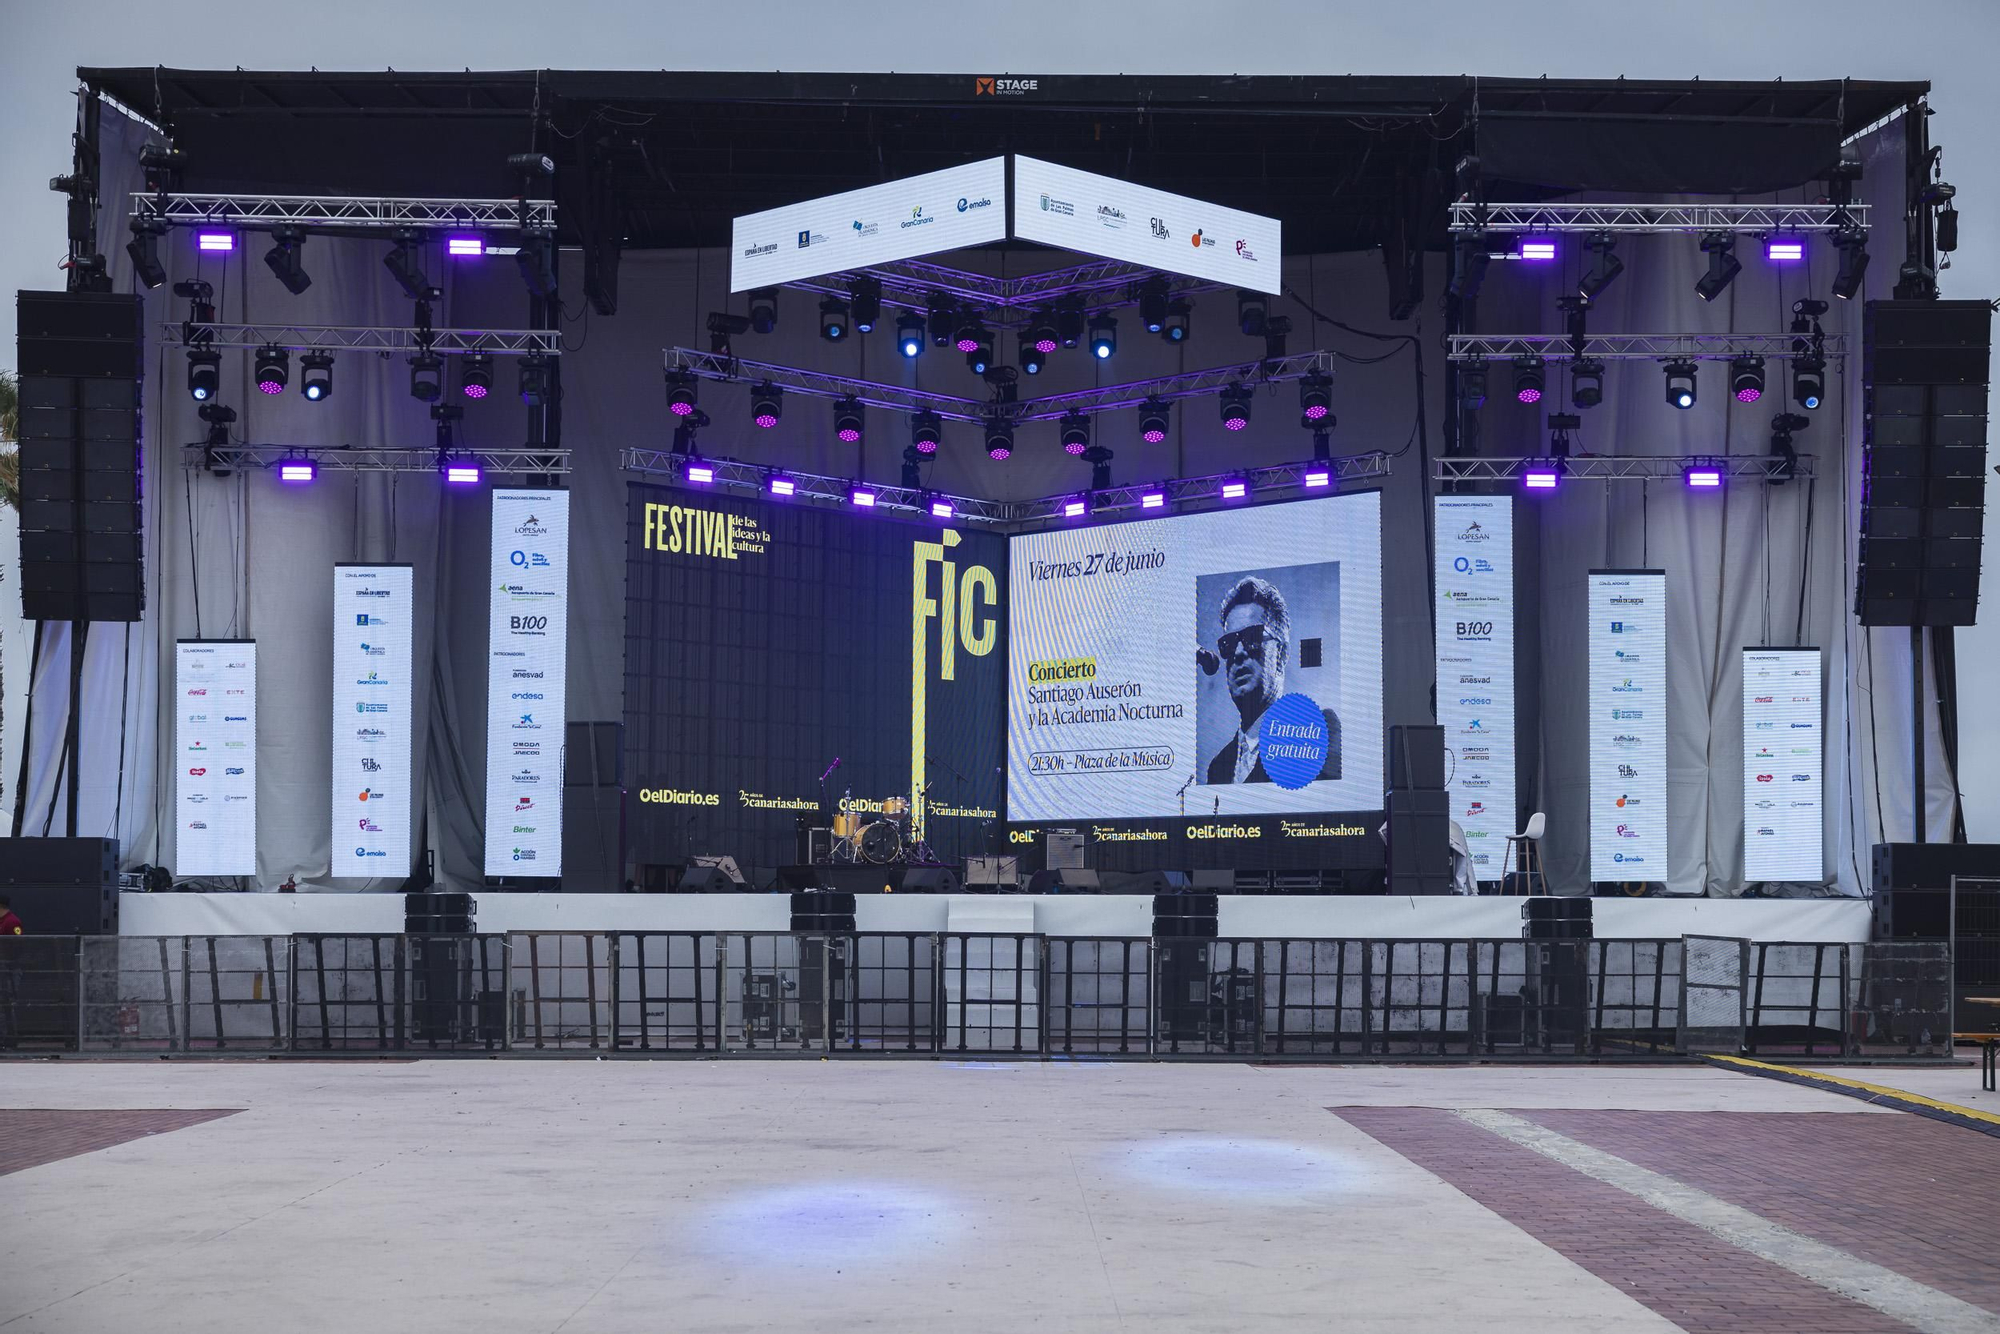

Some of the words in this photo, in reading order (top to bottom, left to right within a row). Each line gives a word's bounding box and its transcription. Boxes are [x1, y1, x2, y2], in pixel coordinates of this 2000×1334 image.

[996, 80, 1038, 90] STAGE
[969, 198, 991, 209] emalsa
[900, 216, 934, 229] GranCanaria
[732, 515, 744, 526] de
[744, 516, 757, 528] las
[644, 502, 738, 560] FESTIVAL
[732, 527, 755, 540] ideas
[756, 532, 762, 543] y
[762, 531, 771, 542] la
[732, 540, 764, 553] cultura
[1029, 560, 1082, 581] Viernes
[1083, 553, 1104, 576] 27
[1105, 552, 1124, 574] de
[1123, 548, 1165, 576] junio
[511, 616, 547, 630] B100
[1456, 621, 1492, 636] B100
[1029, 661, 1097, 682] Concierto
[1460, 676, 1491, 684] anesvad
[512, 692, 543, 700] endesa
[1028, 685, 1084, 706] Santiago
[1086, 681, 1142, 700] Auserón
[1460, 697, 1491, 705] endesa
[1028, 712, 1036, 730] y
[1037, 708, 1049, 726] la
[1051, 705, 1116, 725] Academia
[1118, 702, 1184, 721] Nocturna
[1268, 719, 1321, 740] Entrada
[1265, 742, 1320, 761] gratuita
[1031, 755, 1064, 771] 21:30h
[1074, 754, 1103, 769] Plaza
[1104, 752, 1119, 768] de
[1119, 752, 1131, 767] la
[1131, 751, 1171, 767] Música
[749, 796, 819, 810] canariasahora
[935, 805, 997, 819] canariasahora
[1101, 828, 1168, 842] canariasahora
[1290, 823, 1365, 838] canariasahora
